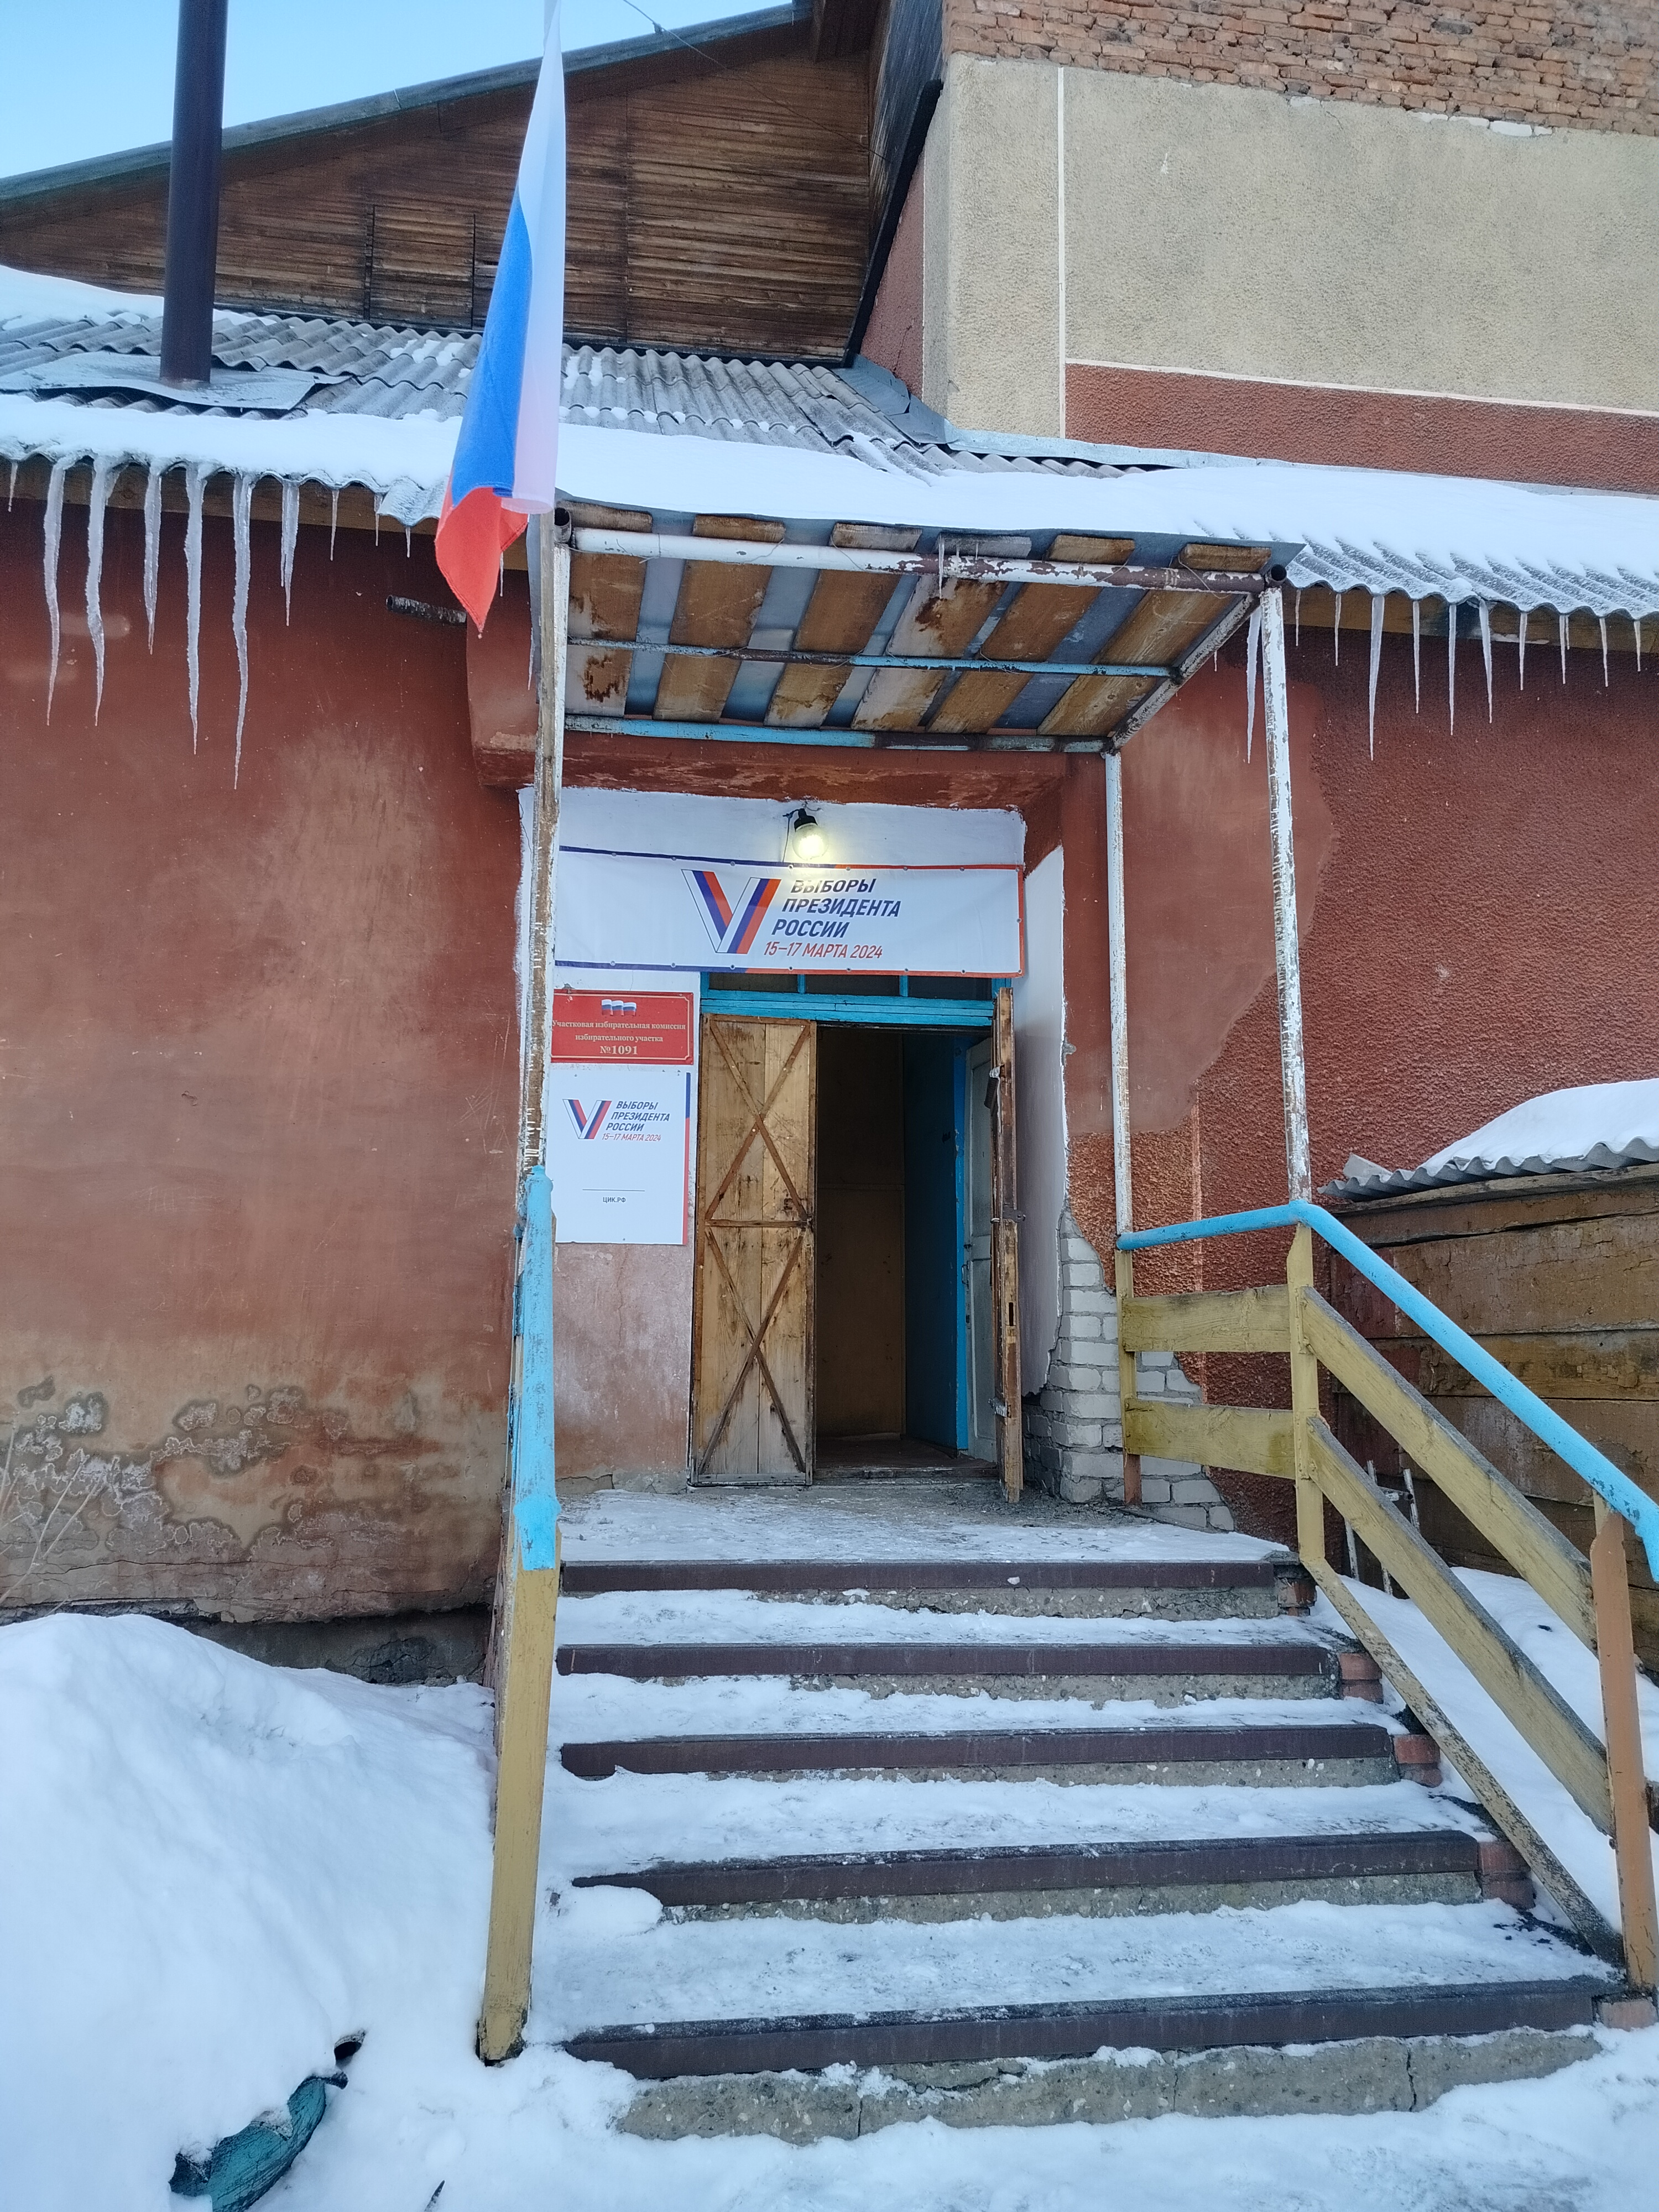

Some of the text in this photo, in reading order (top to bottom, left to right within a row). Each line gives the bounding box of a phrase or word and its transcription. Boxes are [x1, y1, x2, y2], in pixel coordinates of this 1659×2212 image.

[790, 878, 877, 894] ВЫБОРЫ
[782, 898, 901, 917] ПРЕЗИДЕНТА
[771, 919, 850, 938] РОССИИ
[802, 944, 848, 958] МАРТА
[850, 945, 883, 959] 2024
[596, 1021, 650, 1030] избирательная
[575, 1034, 634, 1042] избирательного
[599, 1045, 638, 1055] №1091
[616, 1101, 658, 1110] ВЫБОРЫ
[611, 1112, 670, 1121] ПРЕЗИДЕНТА
[606, 1123, 644, 1131] РОССИИ
